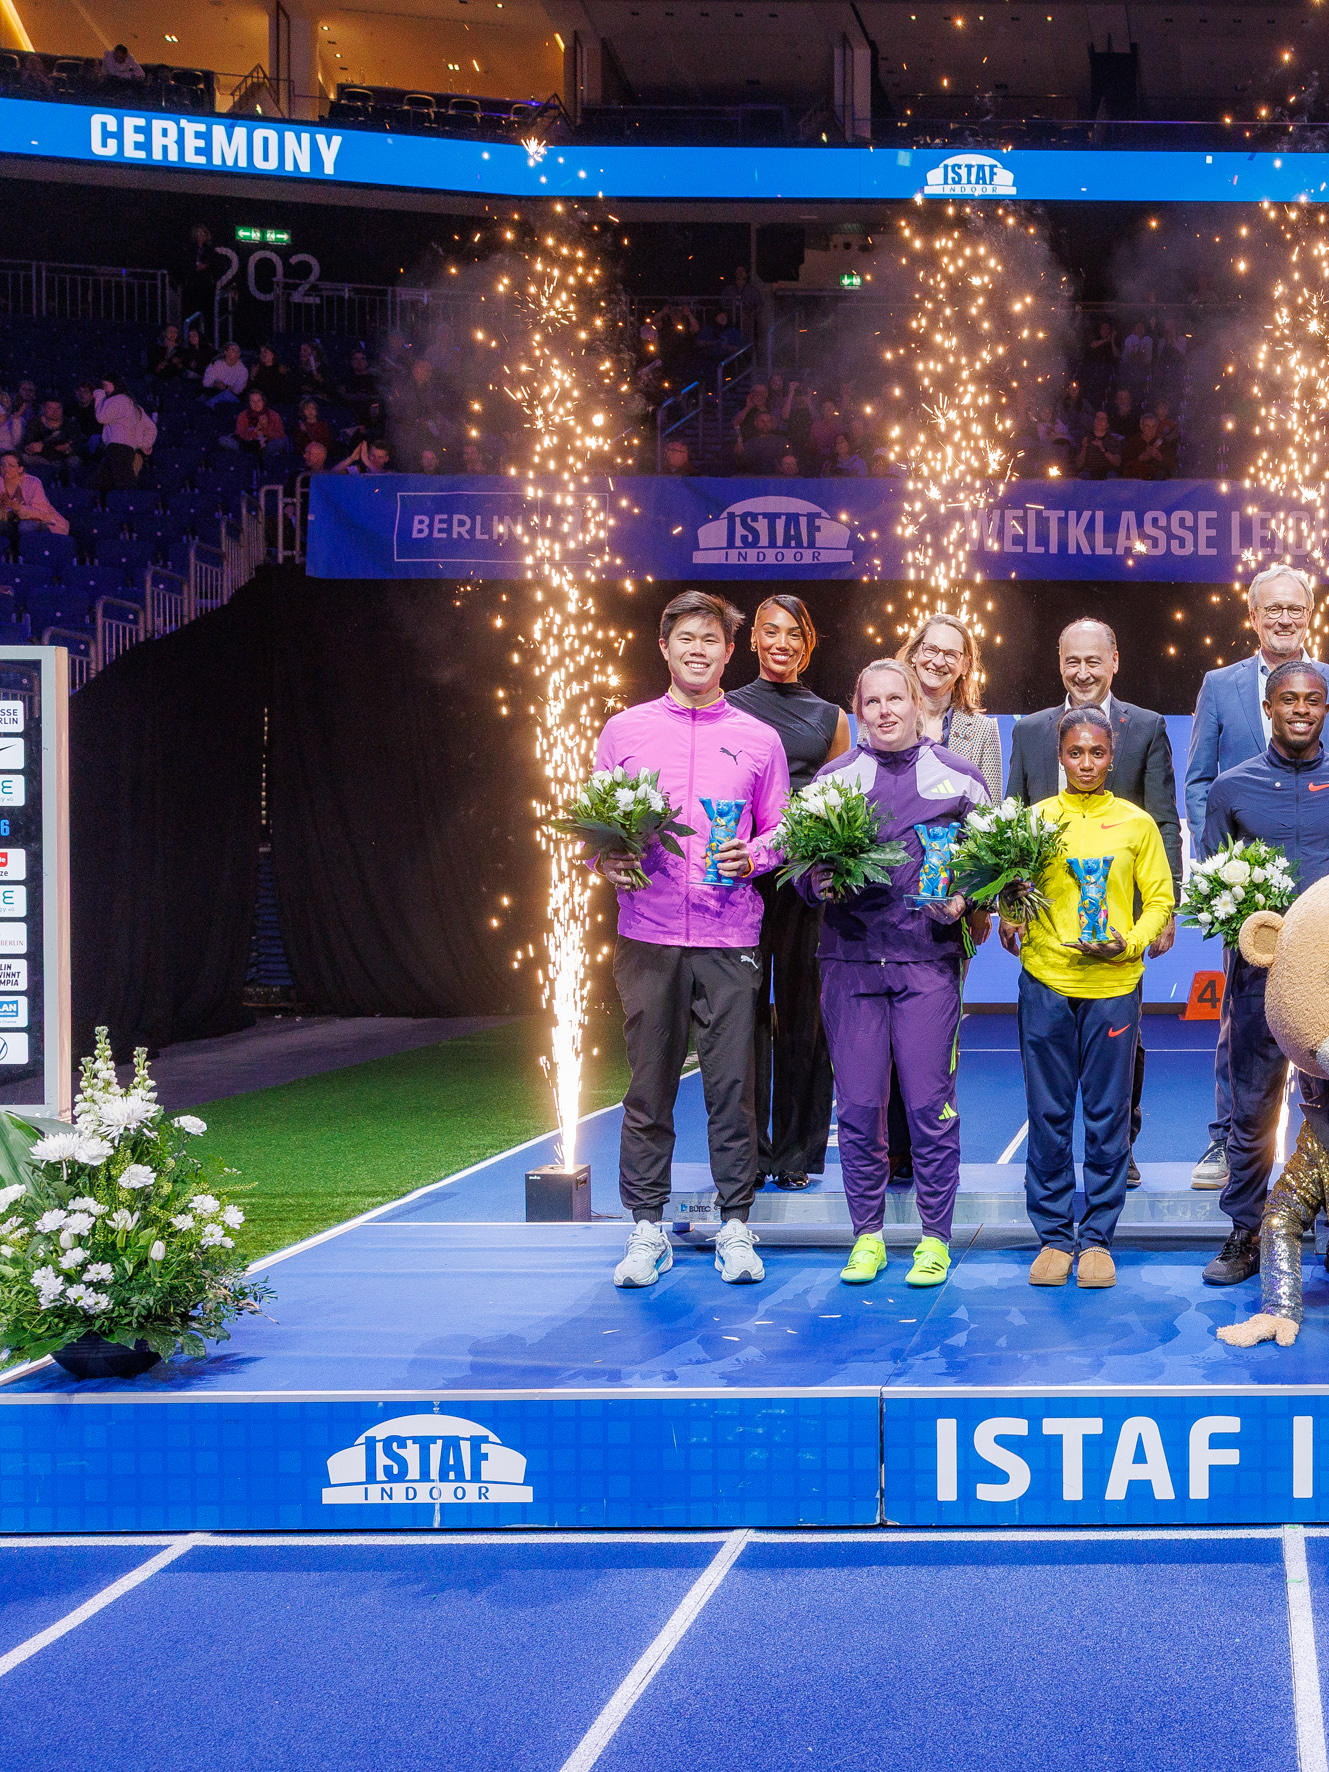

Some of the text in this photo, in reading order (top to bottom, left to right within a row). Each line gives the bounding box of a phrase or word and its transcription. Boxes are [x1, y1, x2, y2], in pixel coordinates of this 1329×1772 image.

[91, 114, 342, 175] CEREMONY
[943, 163, 997, 184] ISTAF
[214, 246, 320, 304] 202
[412, 514, 523, 540] BERLIN
[726, 511, 822, 549] ISTAF
[963, 509, 1217, 555] WELTKLASSE
[724, 551, 821, 562] INDOOR
[1197, 979, 1221, 1009] 4
[365, 1435, 490, 1482] ISTAF
[937, 1415, 1241, 1502] ISTAF
[364, 1486, 490, 1501] INDOOR
